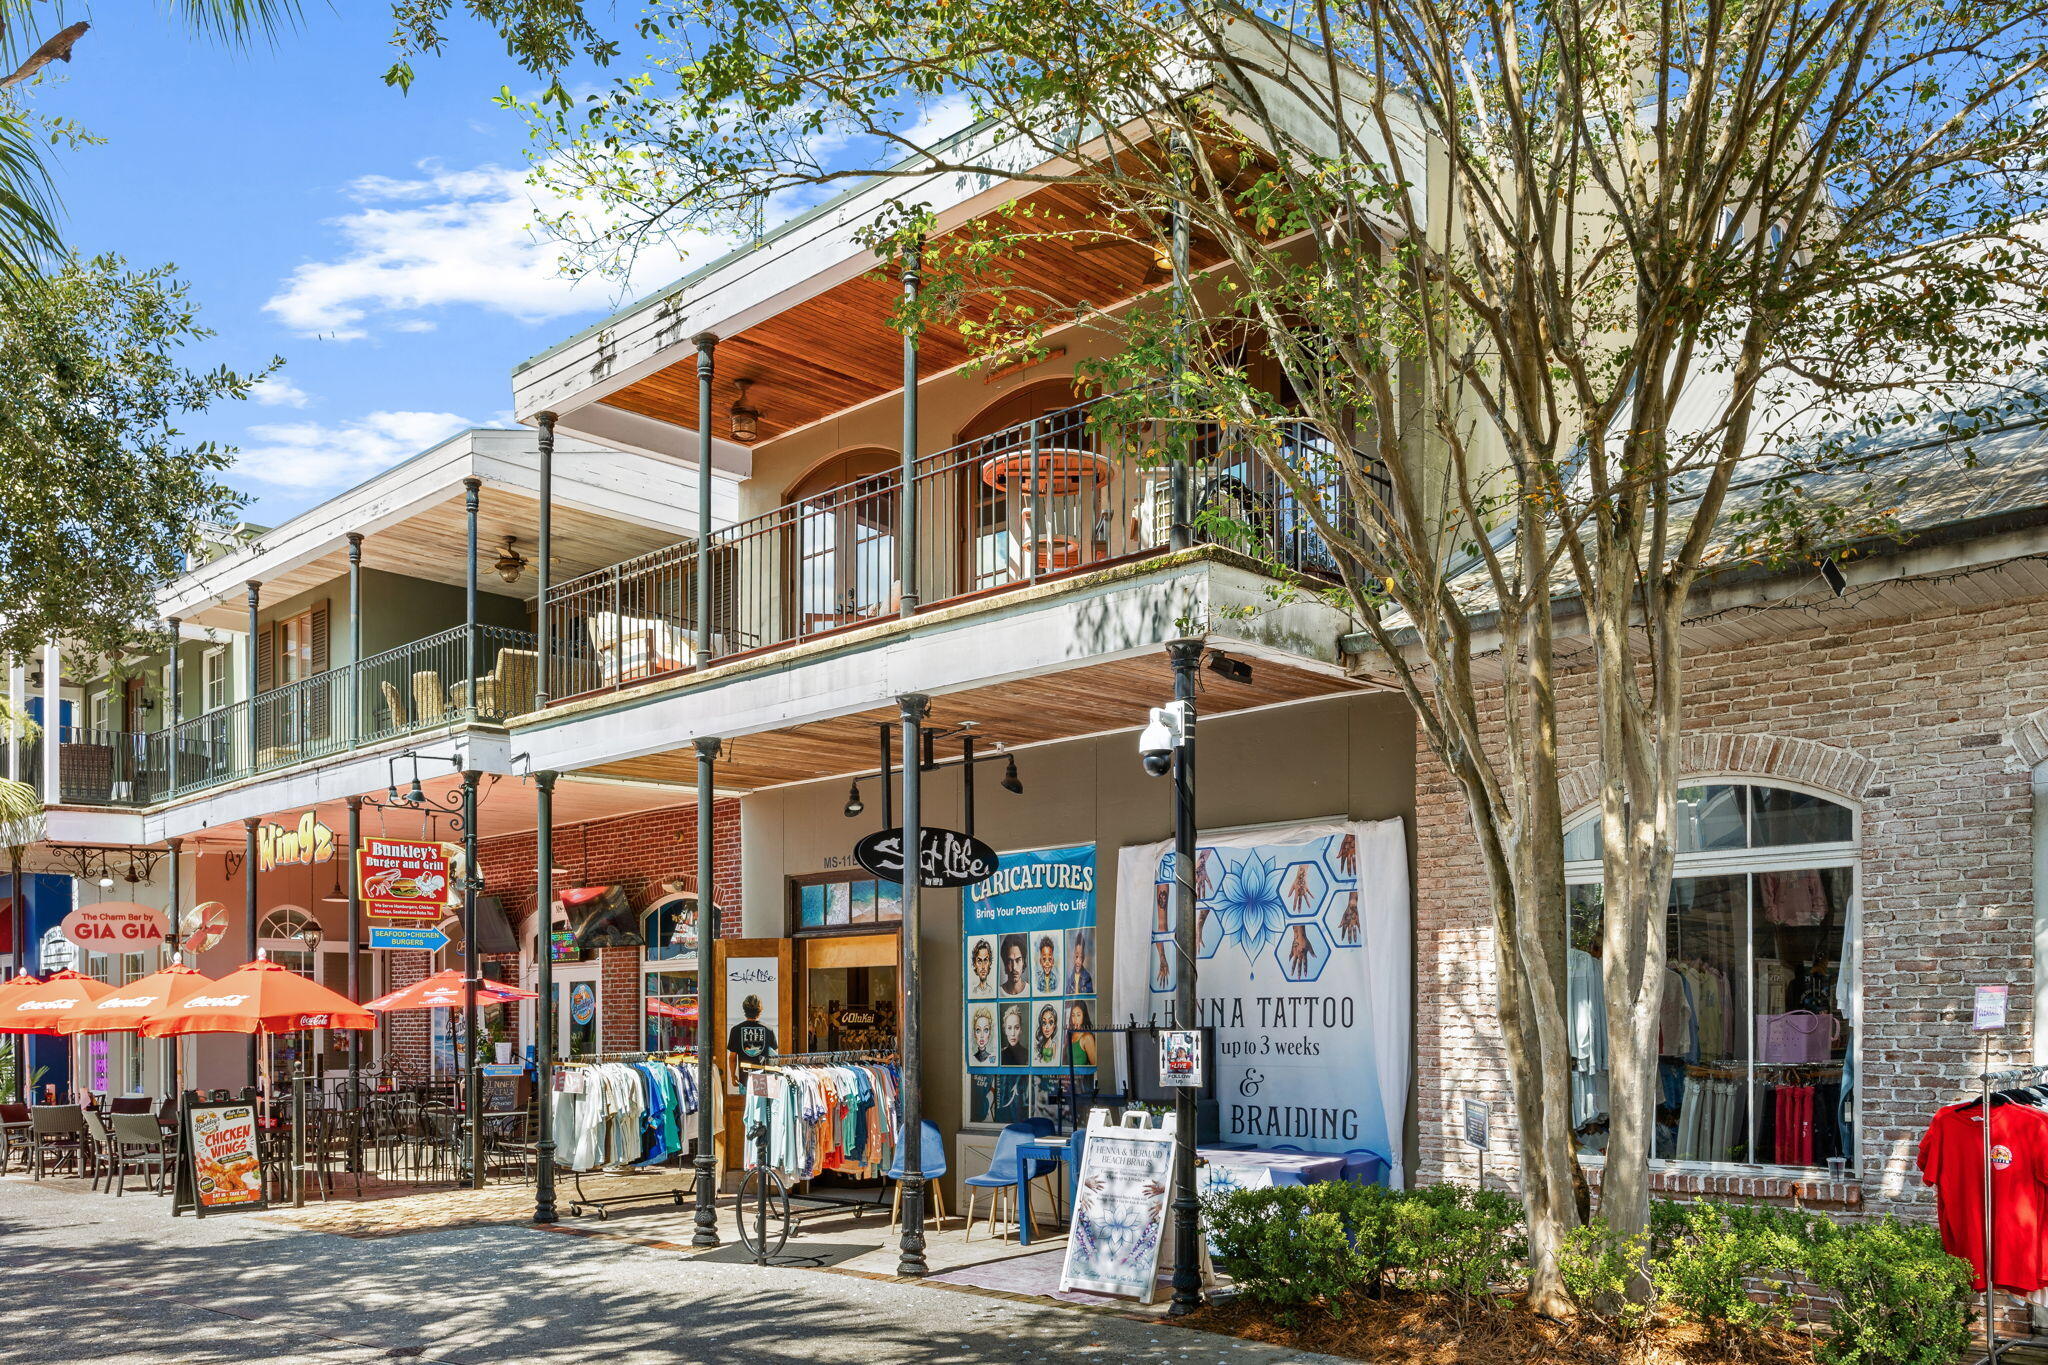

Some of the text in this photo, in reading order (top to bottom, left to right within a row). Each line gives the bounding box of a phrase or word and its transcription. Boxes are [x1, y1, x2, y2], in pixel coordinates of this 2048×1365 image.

[258, 810, 335, 872] Wingz
[372, 842, 437, 860] Bunkley's
[874, 830, 989, 878] Slt Life
[366, 857, 443, 870] Burger and Grill
[971, 864, 1093, 902] CARICATURES
[144, 913, 153, 921] by
[976, 908, 995, 920] Bring
[996, 906, 1014, 917] Your
[1016, 902, 1058, 916] Personality
[1060, 902, 1069, 911] to
[75, 923, 162, 939] GIA GIA
[391, 938, 424, 946] BURGERS
[300, 1014, 328, 1026] Coca-Cola
[1165, 997, 1354, 1028] HNNA TATTOO
[1221, 1035, 1320, 1058] up to 3 weeks
[1239, 1067, 1264, 1097] &
[1231, 1104, 1358, 1140] BRAIDING
[205, 1124, 251, 1147] CHICKEN
[210, 1139, 247, 1158] WINGS
[1096, 1145, 1163, 1159] HENNA & MERMAID
[1101, 1156, 1126, 1165] BEACH
